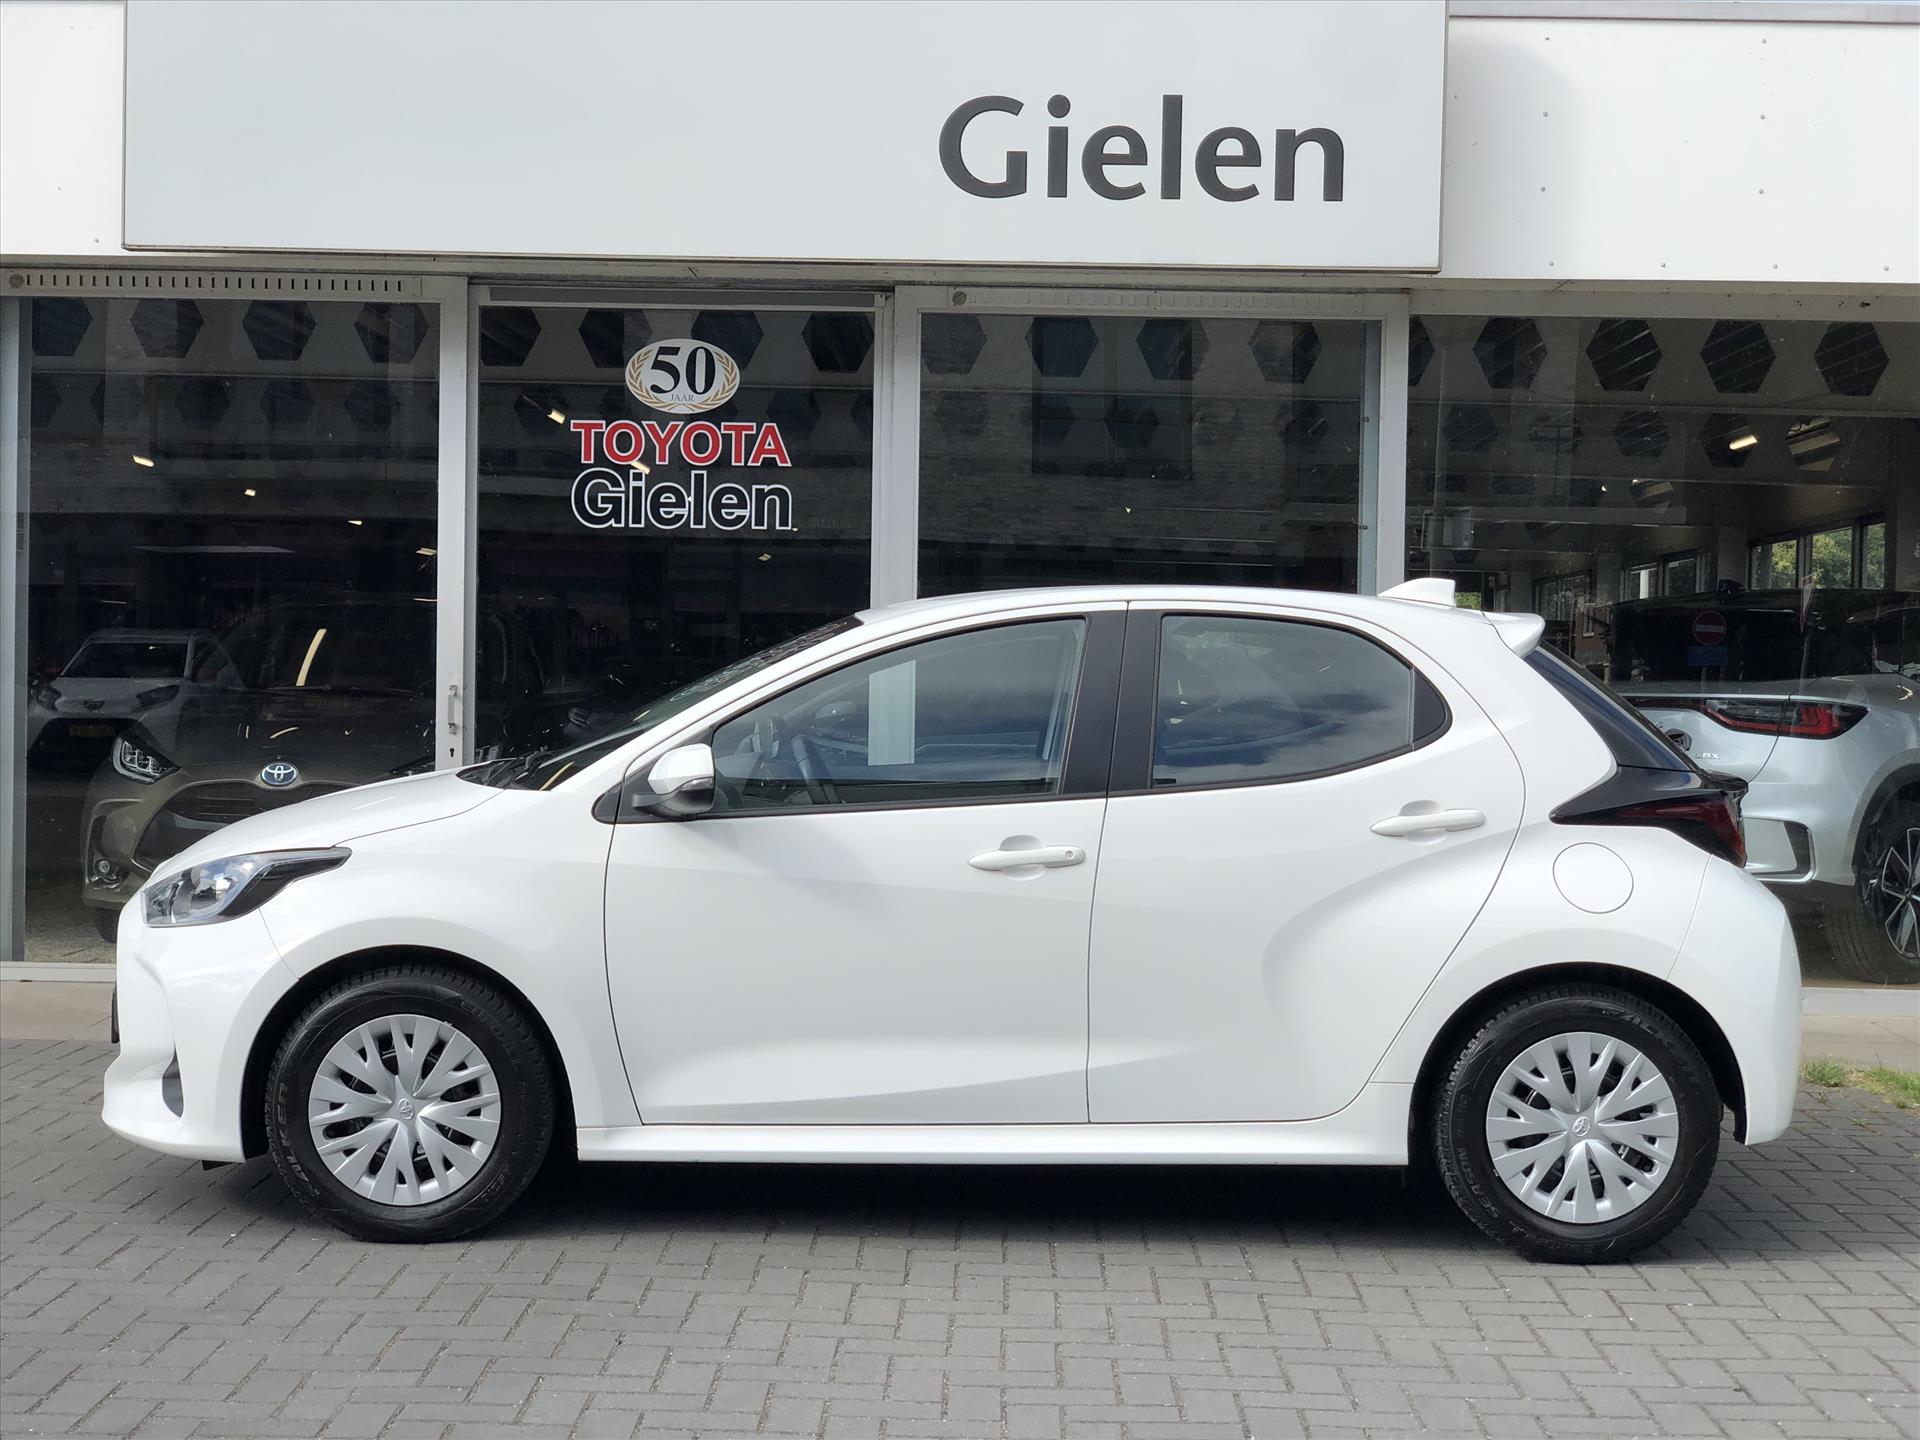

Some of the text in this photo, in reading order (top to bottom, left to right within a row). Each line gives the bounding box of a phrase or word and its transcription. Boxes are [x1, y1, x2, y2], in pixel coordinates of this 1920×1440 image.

[939, 94, 1344, 202] Gielen
[649, 346, 716, 395] 50
[670, 393, 695, 402] JAAR
[570, 420, 793, 467] TOYOTA
[571, 467, 793, 530] Gielen
